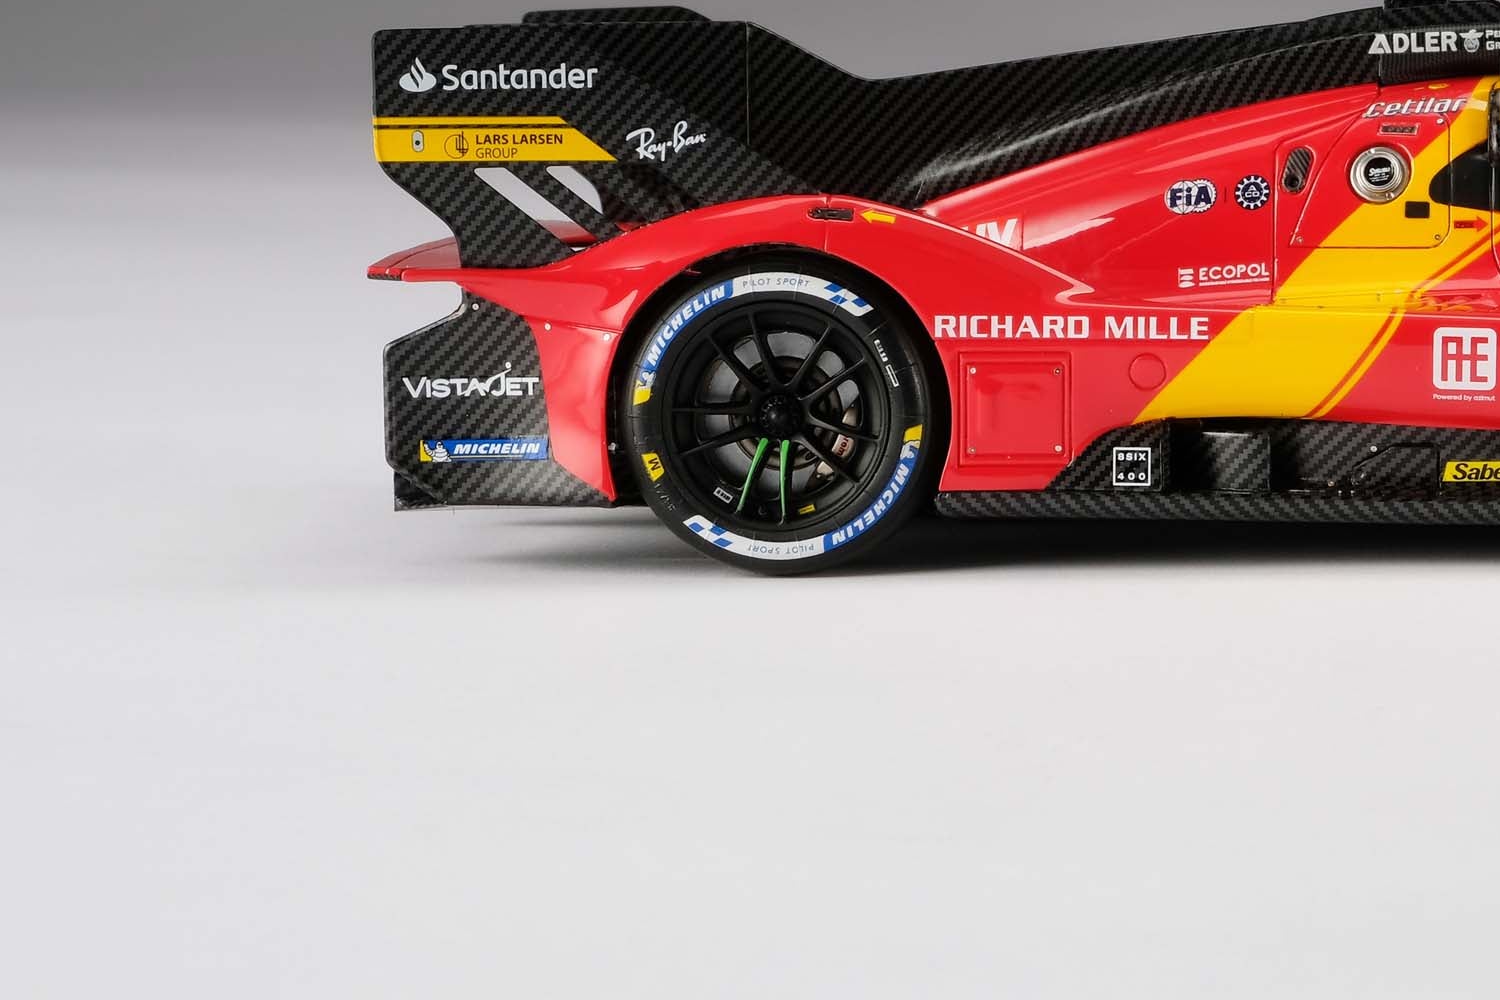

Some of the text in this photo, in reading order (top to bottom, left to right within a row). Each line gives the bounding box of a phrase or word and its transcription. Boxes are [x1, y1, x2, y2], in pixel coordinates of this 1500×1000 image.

[1367, 31, 1458, 54] ADLER
[442, 62, 598, 91] Santander
[475, 134, 563, 145] LARS LARSEN
[475, 147, 518, 159] GROUP
[1199, 262, 1270, 281] ECOPOL
[648, 284, 727, 367] MICHELIN
[934, 315, 1210, 341] RICHARD MILLE
[1432, 393, 1463, 401] Powered
[1464, 394, 1472, 402] by
[453, 442, 541, 455] MICHELIN
[1117, 452, 1147, 461] 8SIX
[832, 463, 910, 546] MICHELIN
